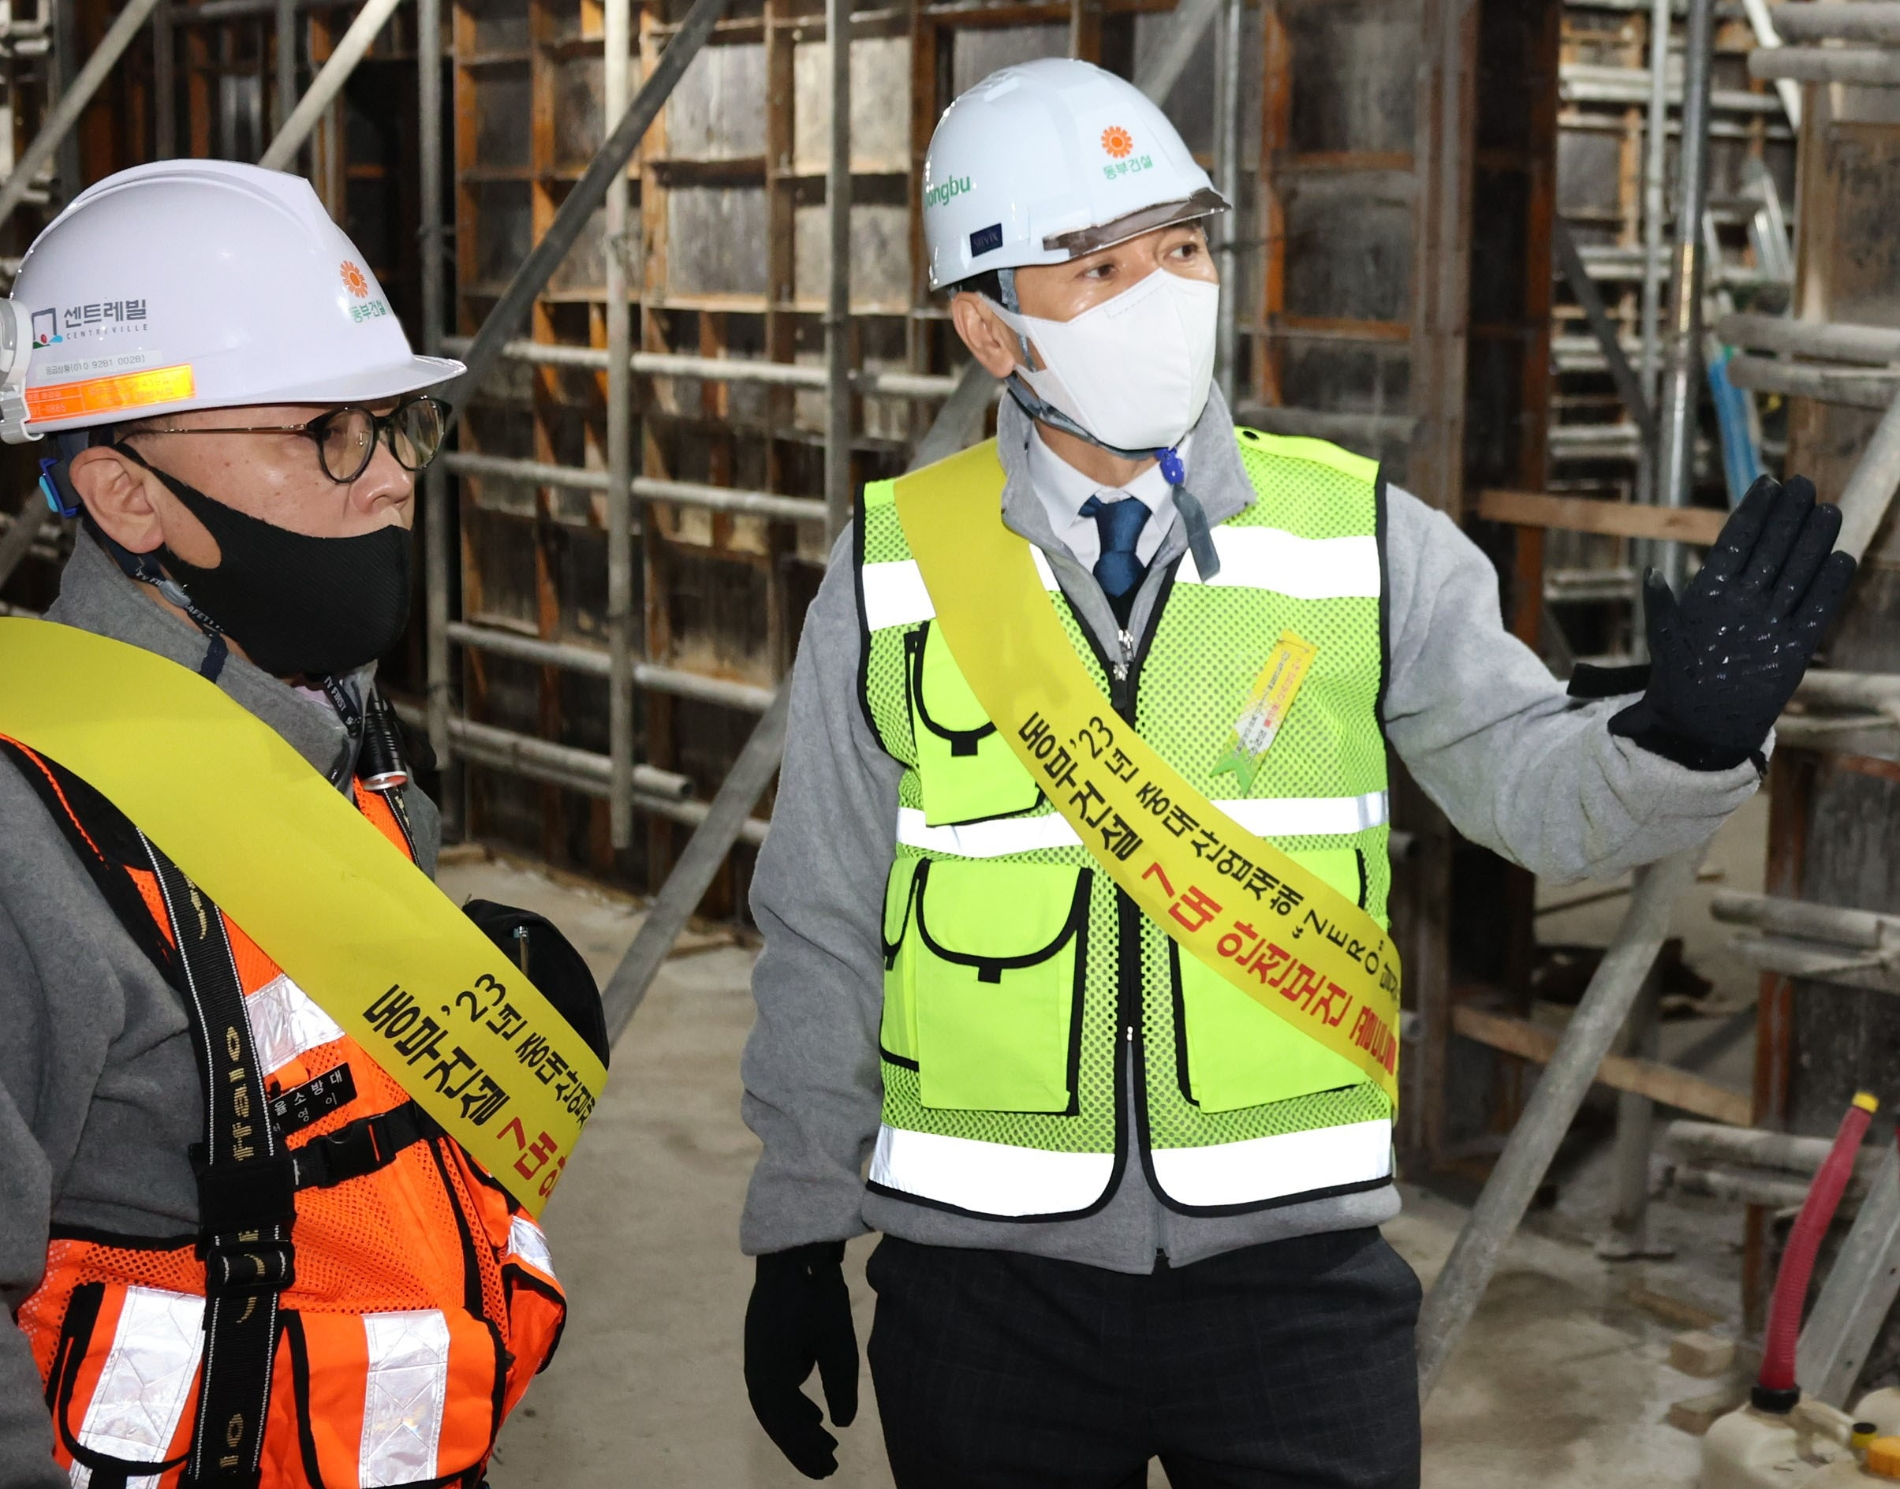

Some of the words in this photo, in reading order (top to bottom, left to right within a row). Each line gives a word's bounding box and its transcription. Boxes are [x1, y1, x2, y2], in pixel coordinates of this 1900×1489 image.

[1103, 154, 1153, 180] 동부건설
[924, 174, 971, 210] ongbu
[63, 299, 147, 329] 센트레빌
[349, 300, 387, 323] 동부건설
[66, 323, 149, 340] CENTREVILLE
[1069, 716, 1140, 782] '23년
[1136, 781, 1304, 916] 중대산업재해
[1018, 711, 1144, 862] 동부건설
[1141, 862, 1223, 933] 7대
[1217, 920, 1354, 1028] 안전보건
[440, 973, 528, 1041] '23년
[362, 983, 511, 1127] 동부건설
[496, 1116, 558, 1181] 7대
